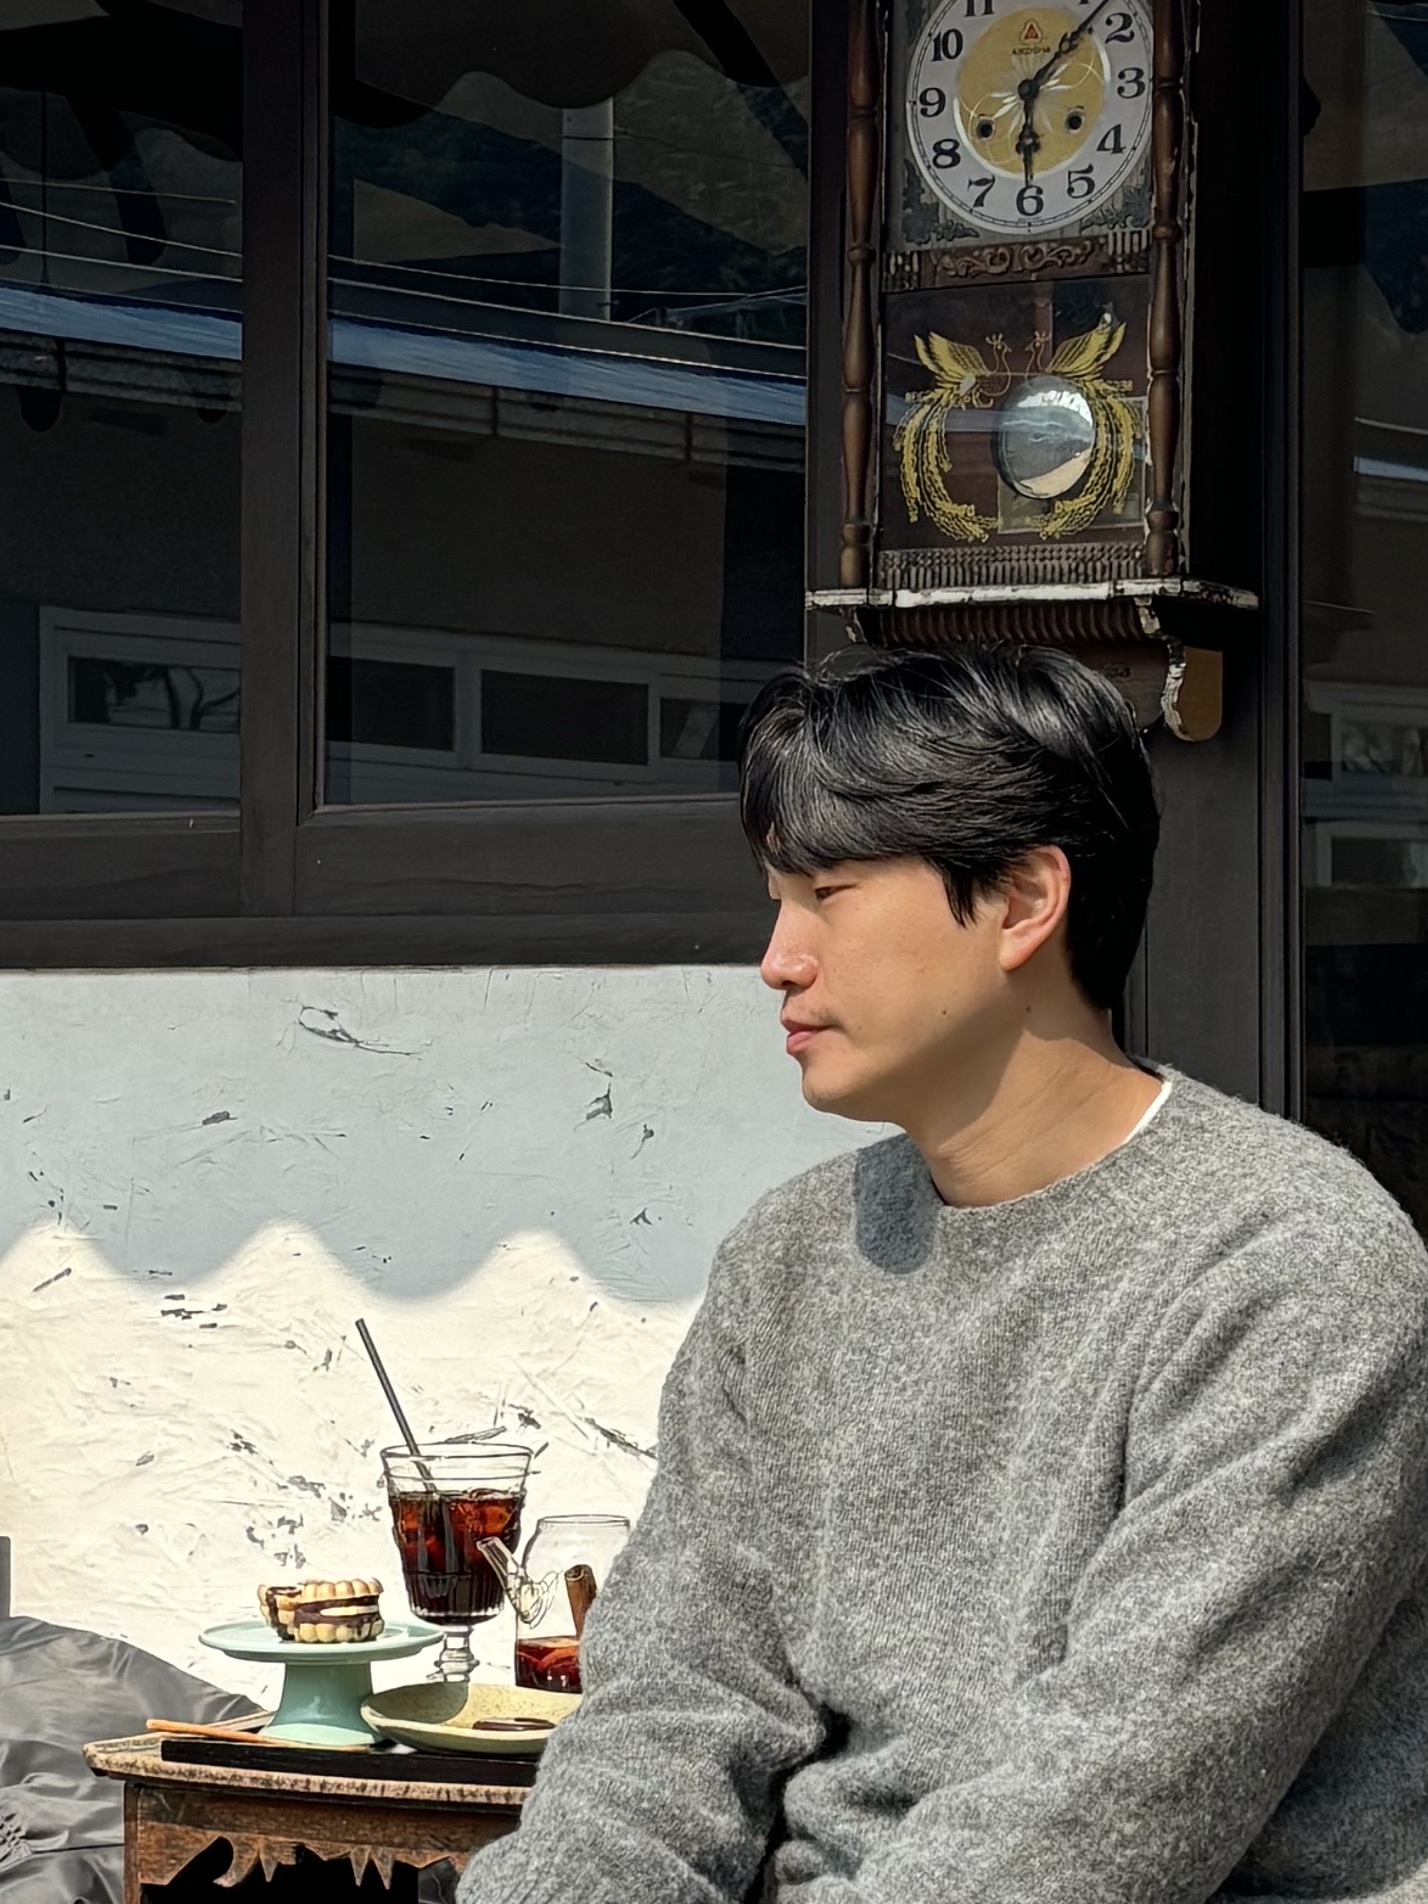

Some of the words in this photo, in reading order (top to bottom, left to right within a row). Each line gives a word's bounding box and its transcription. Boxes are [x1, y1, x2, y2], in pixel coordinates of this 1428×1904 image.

[1104, 12, 1135, 44] 2
[930, 28, 963, 61] 10
[1117, 67, 1146, 99] 3
[919, 87, 946, 117] 9
[932, 139, 961, 169] 8
[1097, 124, 1126, 155] 4
[967, 175, 996, 207] 7
[1066, 164, 1095, 198] 5
[1015, 185, 1044, 216] 6
